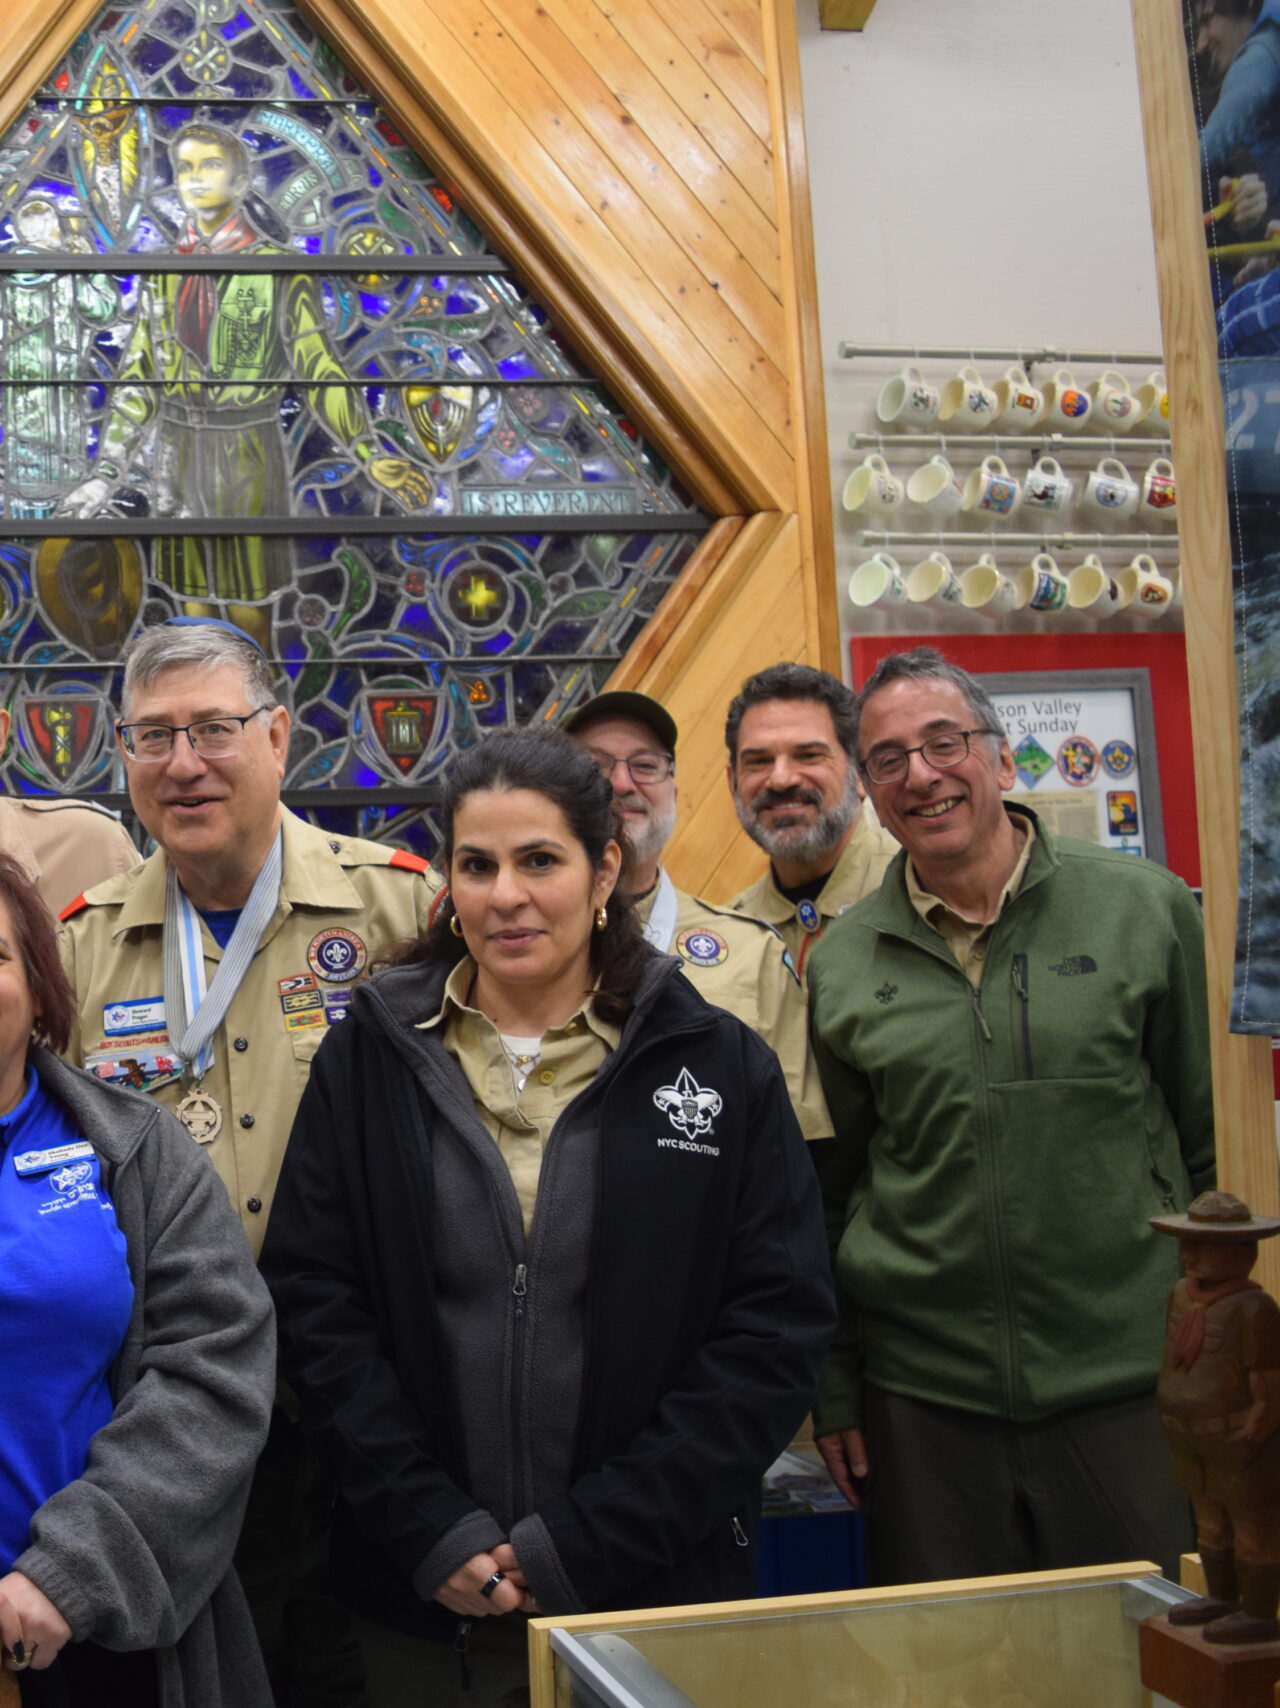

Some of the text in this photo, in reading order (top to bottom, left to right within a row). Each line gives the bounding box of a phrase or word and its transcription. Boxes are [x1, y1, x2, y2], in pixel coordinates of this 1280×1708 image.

[467, 491, 628, 515] IS REVERENT
[992, 698, 1082, 718] son Valley
[1017, 716, 1078, 735] Sunday
[657, 1137, 720, 1157] NYC SCOUTING
